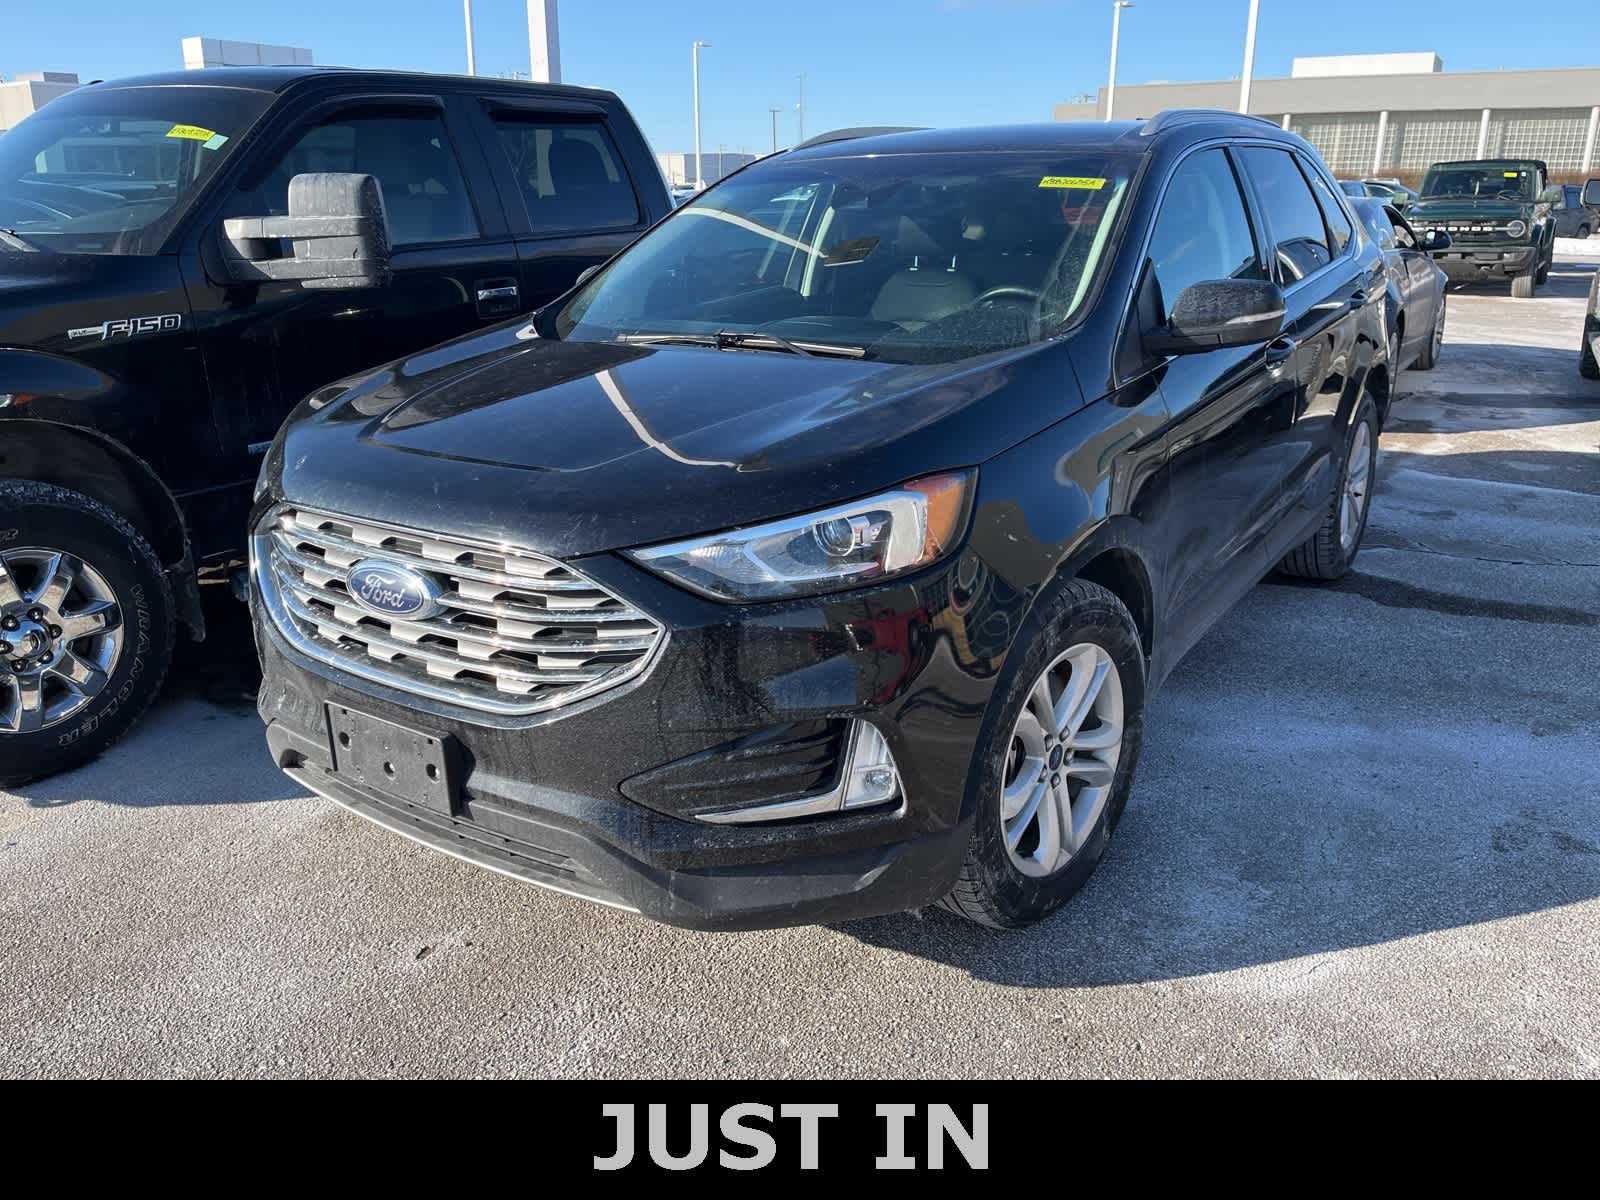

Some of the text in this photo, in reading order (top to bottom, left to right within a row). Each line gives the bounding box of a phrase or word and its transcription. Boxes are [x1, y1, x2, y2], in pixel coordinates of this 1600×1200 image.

[101, 313, 182, 341] F-150
[361, 574, 405, 608] Ford
[58, 584, 150, 745] WRANGLER
